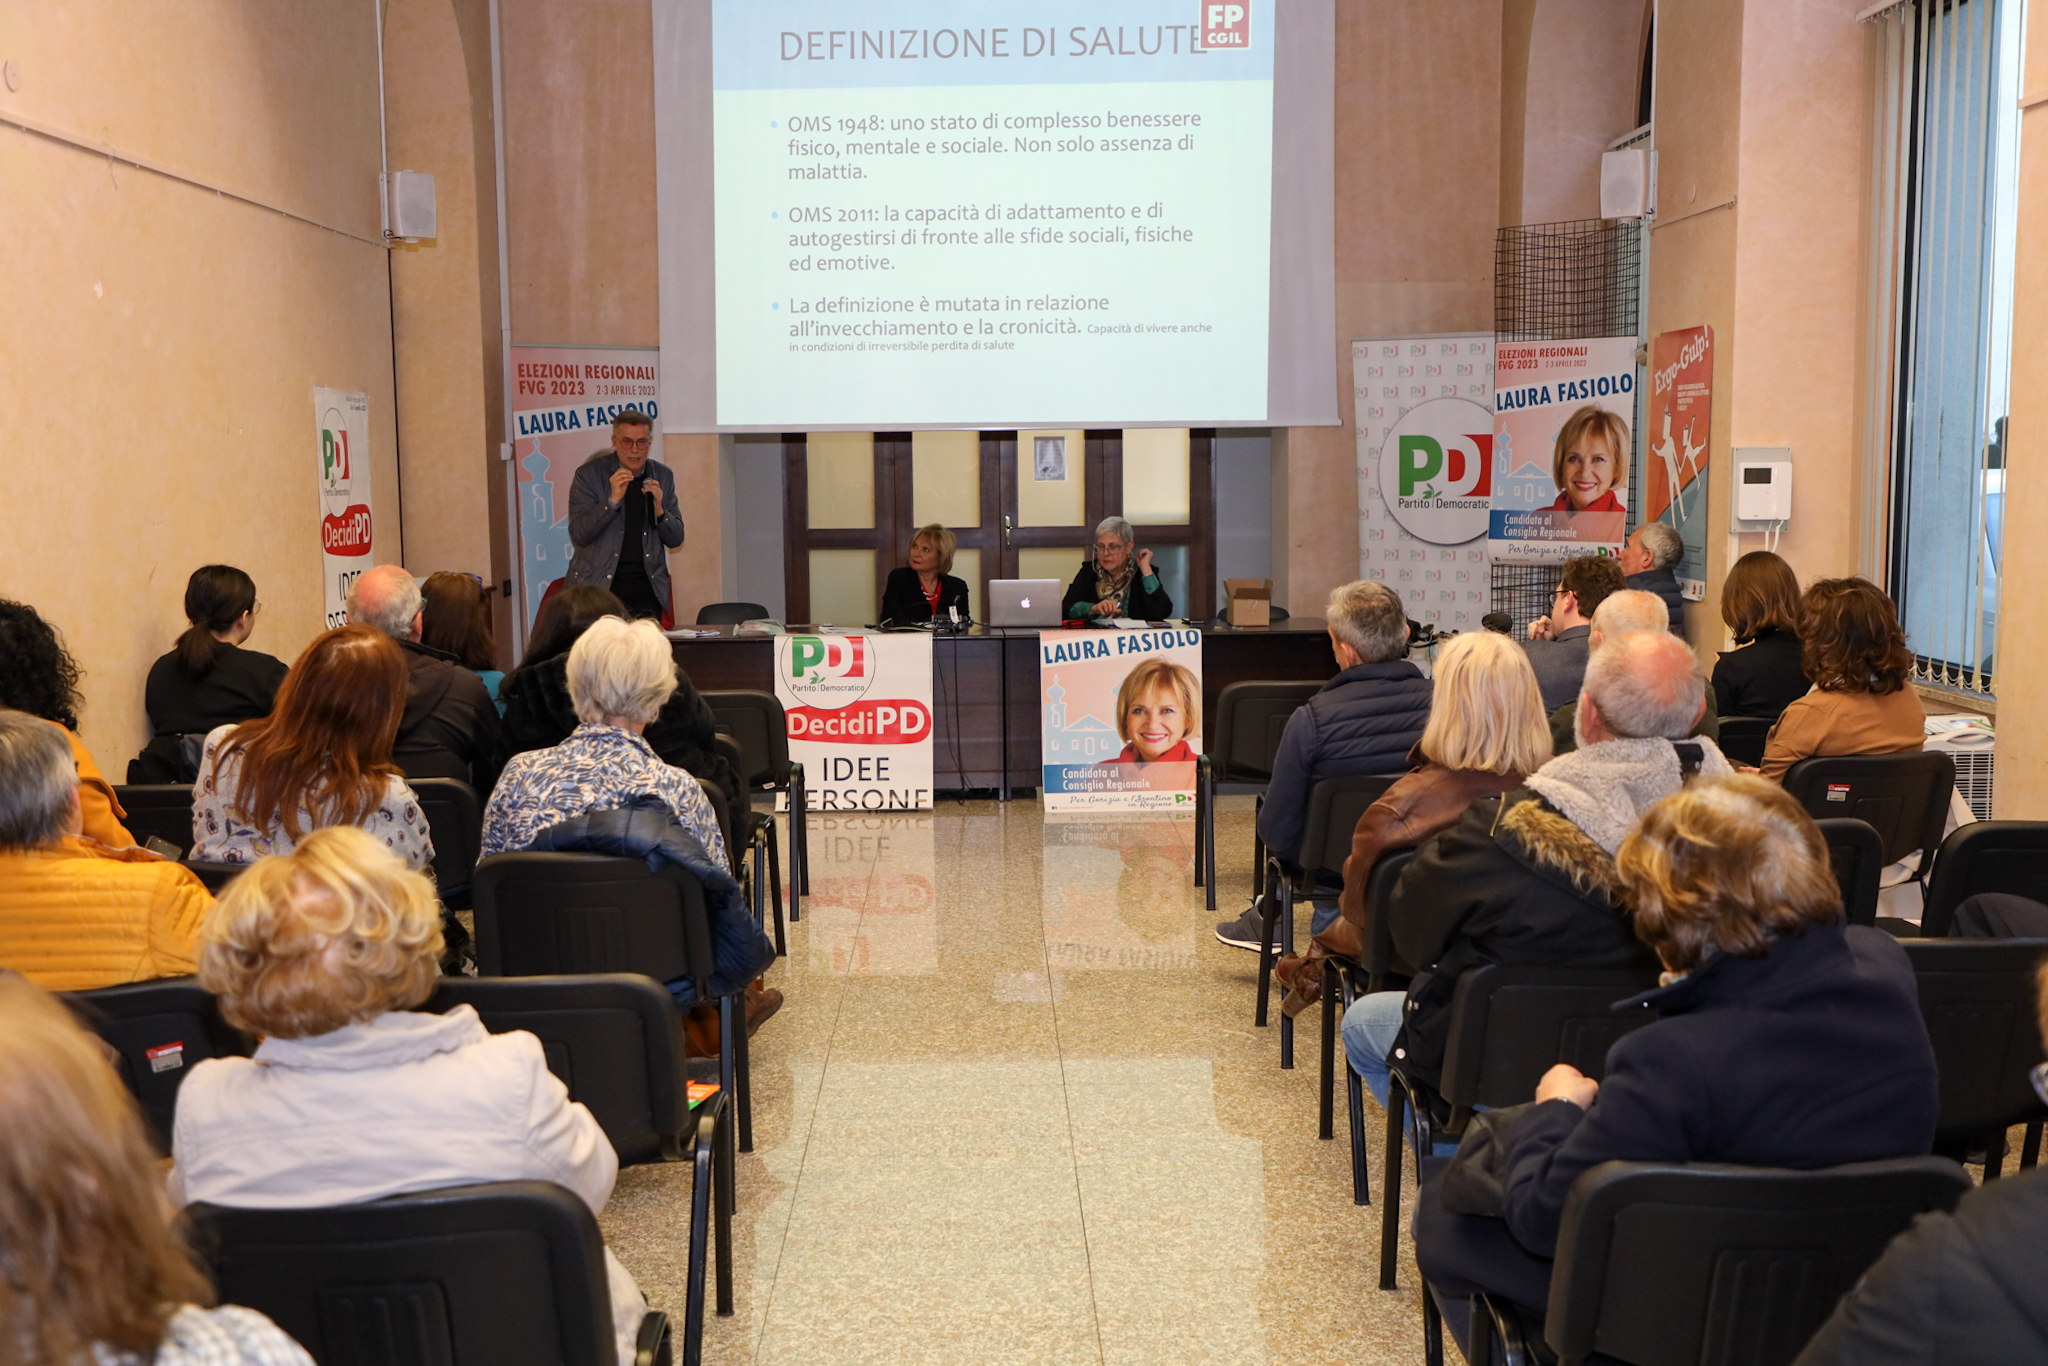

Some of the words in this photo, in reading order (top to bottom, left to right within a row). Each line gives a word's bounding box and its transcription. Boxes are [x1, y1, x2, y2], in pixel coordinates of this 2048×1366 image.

[1208, 4, 1244, 29] FP
[780, 29, 1009, 60] DEFINIZIONE
[1023, 27, 1056, 57] DI
[1069, 25, 1207, 57] SALUTE
[1207, 32, 1242, 44] CGIL
[788, 116, 831, 132] OMS
[838, 115, 884, 135] 1948:
[891, 118, 925, 130] uno
[931, 115, 977, 130] stato
[983, 113, 998, 129] di
[1004, 112, 1101, 133] complesso
[1108, 111, 1201, 127] benessere
[788, 139, 840, 159] fisico,
[846, 138, 920, 155] mentale
[926, 142, 936, 154] e
[942, 136, 1008, 153] sociale.
[1015, 137, 1051, 152] Non
[1057, 135, 1094, 152] solo
[1100, 139, 1171, 151] assenza
[1178, 134, 1193, 150] di
[789, 163, 867, 179] malattia.
[789, 207, 832, 223] OMS
[838, 209, 878, 222] 2011:
[885, 205, 899, 221] la
[905, 204, 979, 224] capacità
[985, 204, 1001, 220] di
[1007, 203, 1125, 220] adattamento
[1131, 206, 1141, 218] e
[1147, 202, 1162, 218] di
[789, 230, 895, 251] autogestirsi
[901, 229, 916, 245] di
[921, 228, 978, 245] fronte
[984, 227, 1014, 244] alle
[1021, 227, 1063, 243] sfide
[1069, 226, 1129, 246] sociali,
[1135, 225, 1193, 242] fisiche
[789, 255, 810, 271] ed
[817, 255, 895, 271] emotive.
[790, 298, 809, 313] La
[815, 296, 914, 313] definizione
[920, 296, 929, 312] è
[936, 297, 999, 311] mutata
[1006, 295, 1020, 310] in
[1027, 294, 1109, 310] relazione
[963, 323, 973, 335] e
[979, 318, 993, 334] la
[999, 317, 1081, 334] cronicità.
[1087, 324, 1131, 336] Capacità
[1134, 323, 1143, 333] di
[1147, 324, 1178, 333] vivere
[1181, 323, 1212, 332] anche
[789, 343, 798, 351] in
[802, 342, 853, 351] condizioni
[857, 342, 865, 351] di
[869, 341, 929, 351] irreversibile
[932, 341, 968, 352] perdita
[971, 340, 980, 350] di
[984, 340, 1014, 349] salute
[1499, 349, 1536, 359] ELEZIONI
[1540, 346, 1588, 358] REGIONALI
[1499, 360, 1514, 370] FVG
[1517, 359, 1538, 370] 2023
[1555, 360, 1572, 368] APRILE
[1573, 359, 1587, 367] 2023
[1654, 325, 1710, 396] Ergo-Gulp!
[518, 363, 579, 379] ELEZIONI
[585, 365, 655, 380] REGIONALI
[519, 381, 546, 395] FVG
[551, 381, 585, 395] 2023
[597, 385, 608, 395] 2-3
[611, 386, 636, 395] APRILE
[638, 386, 655, 396] 2023
[1496, 386, 1552, 411] LAURA
[1558, 373, 1633, 402] FASIOLO
[519, 410, 581, 435] LAURA
[1399, 434, 1493, 497] PD
[1398, 498, 1430, 508] Partito
[1436, 499, 1490, 509] Democratic
[1504, 513, 1542, 525] Candidata
[1544, 515, 1552, 525] al
[325, 512, 371, 549] DecidiPD
[1503, 526, 1538, 539] Consiglio
[1539, 526, 1577, 540] Regionale
[1508, 544, 1523, 554] Per
[1523, 544, 1551, 557] Gorizia
[1044, 639, 1111, 664] LAURA
[1117, 630, 1200, 654] FASIOLO
[792, 636, 864, 677] PD
[792, 684, 816, 692] Partito
[820, 684, 865, 692] Democratico
[788, 706, 925, 735] DecidiPD
[823, 757, 890, 781] IDEE
[1063, 768, 1107, 779] Candidata
[1110, 767, 1119, 778] al
[1063, 779, 1104, 792] Consiglio
[1106, 779, 1151, 791] Regionale
[1070, 796, 1086, 804] Per
[1088, 795, 1121, 805] Gorizia
[1139, 800, 1173, 809] Regione
